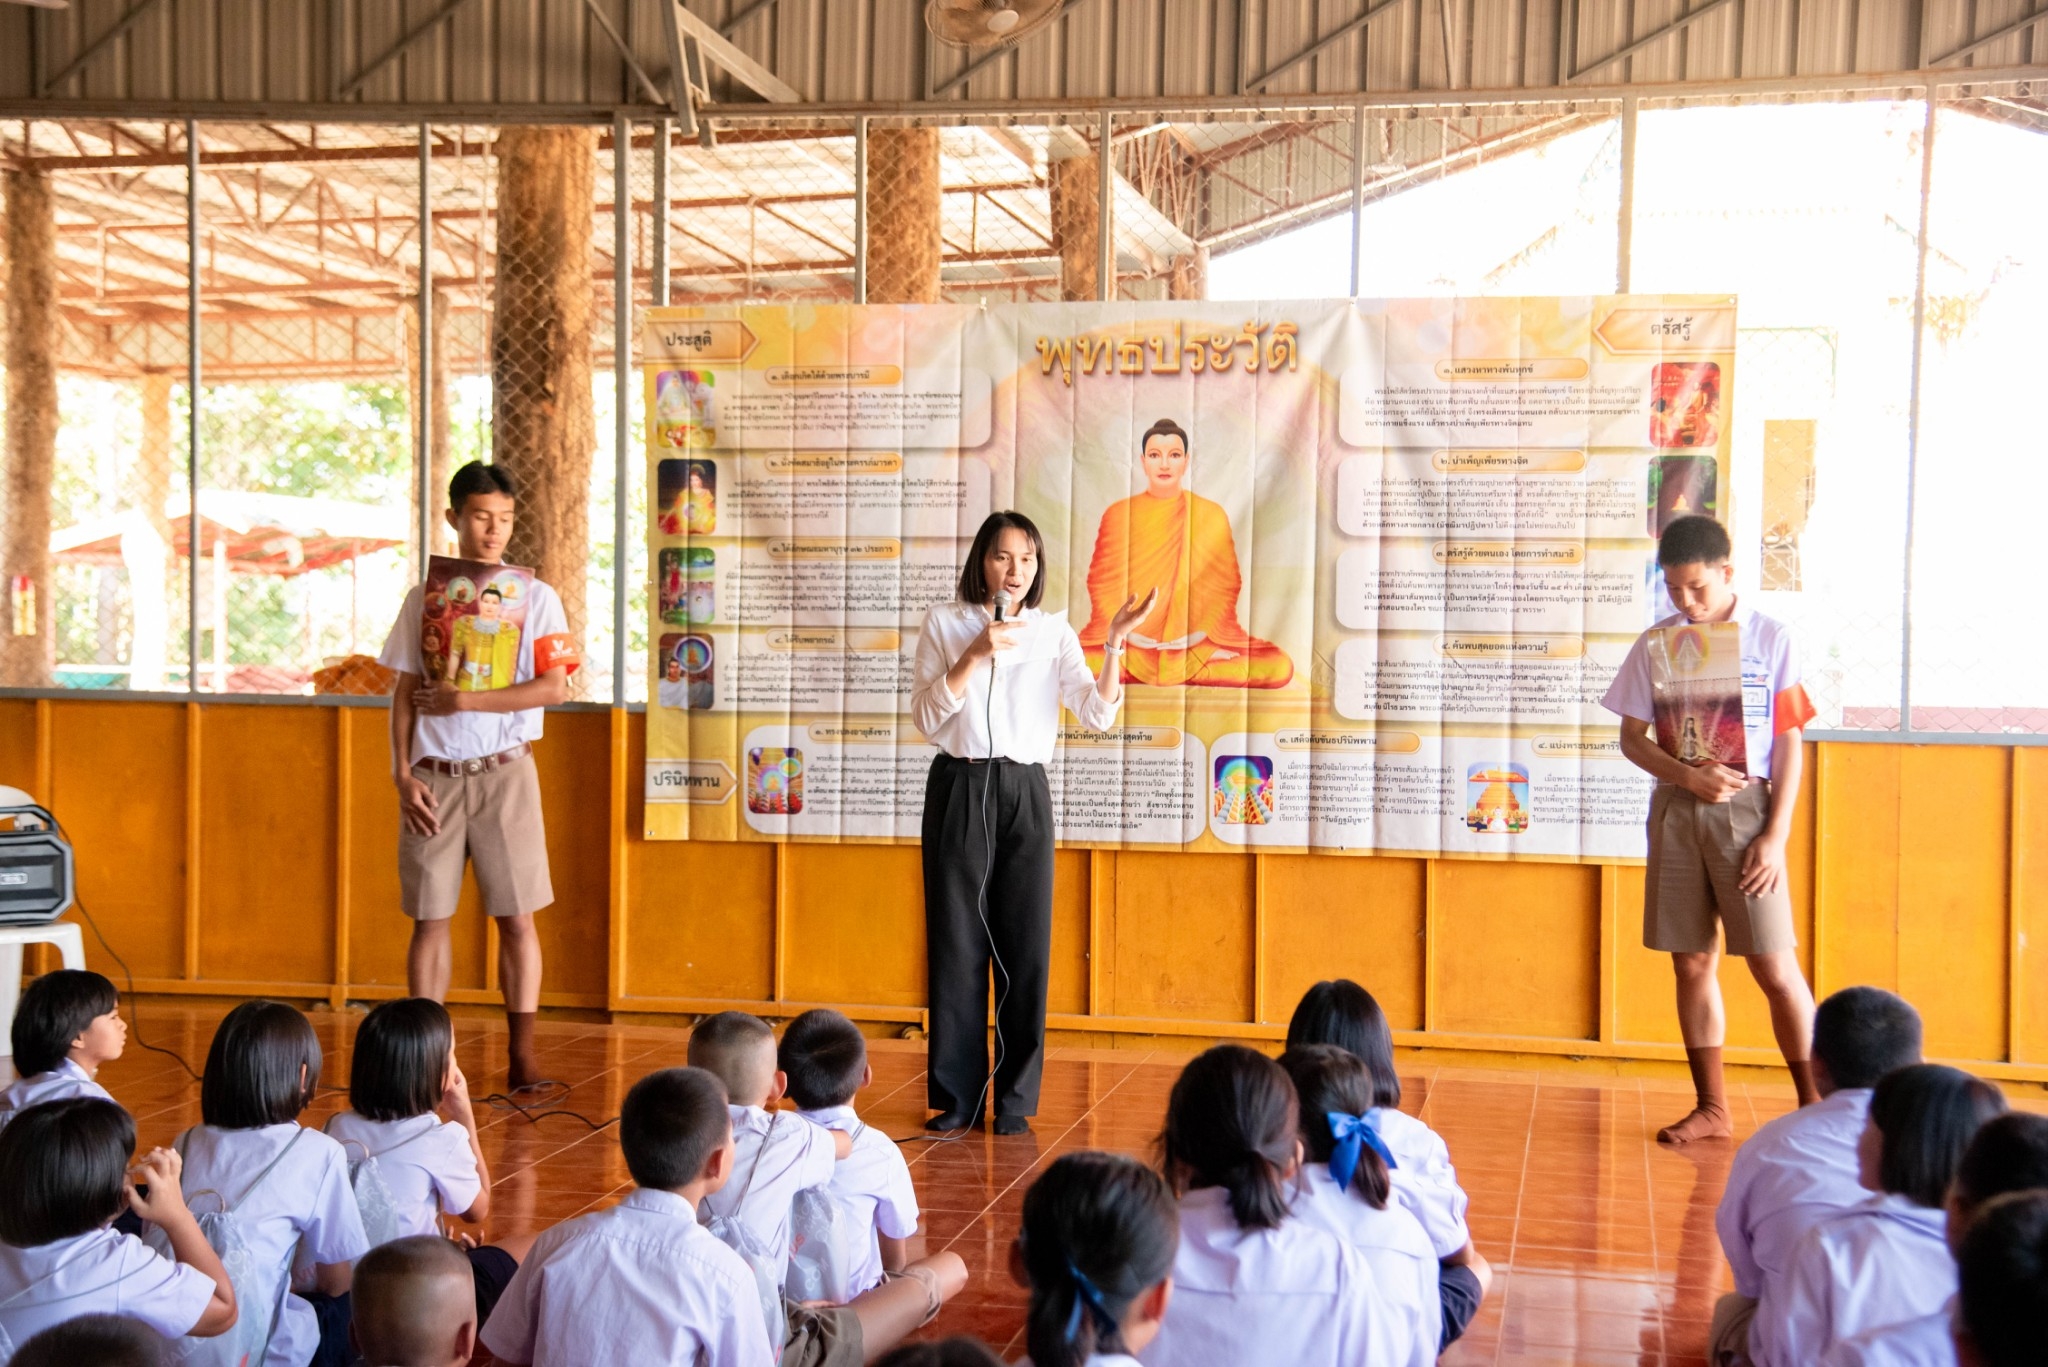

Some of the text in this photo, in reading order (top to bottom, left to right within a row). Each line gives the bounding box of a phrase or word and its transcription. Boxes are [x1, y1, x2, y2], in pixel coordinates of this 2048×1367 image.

[1650, 316, 1693, 341] ตรัสรู้
[665, 330, 712, 352] ประสูติ
[1035, 317, 1299, 388] พุทธประวัติ
[1454, 363, 1534, 377] แสวงหาทางพ้นทุกข์
[1452, 455, 1528, 467] บำเพ็ญเพียรทางจิต
[863, 543, 893, 553] ประการ
[1446, 547, 1509, 561] ตรัสรู้ด้วยตนเอง
[1511, 547, 1575, 559] โดยการทำสมาธิ
[1452, 639, 1549, 655] ค้นพบสุดยอดแห่งความรู้
[826, 726, 891, 739] ทรงปลงอายุสังขาร
[1290, 732, 1377, 746] เสด็จดับขันธปรินิพพาน
[652, 769, 721, 788] ปรินิพพาน
